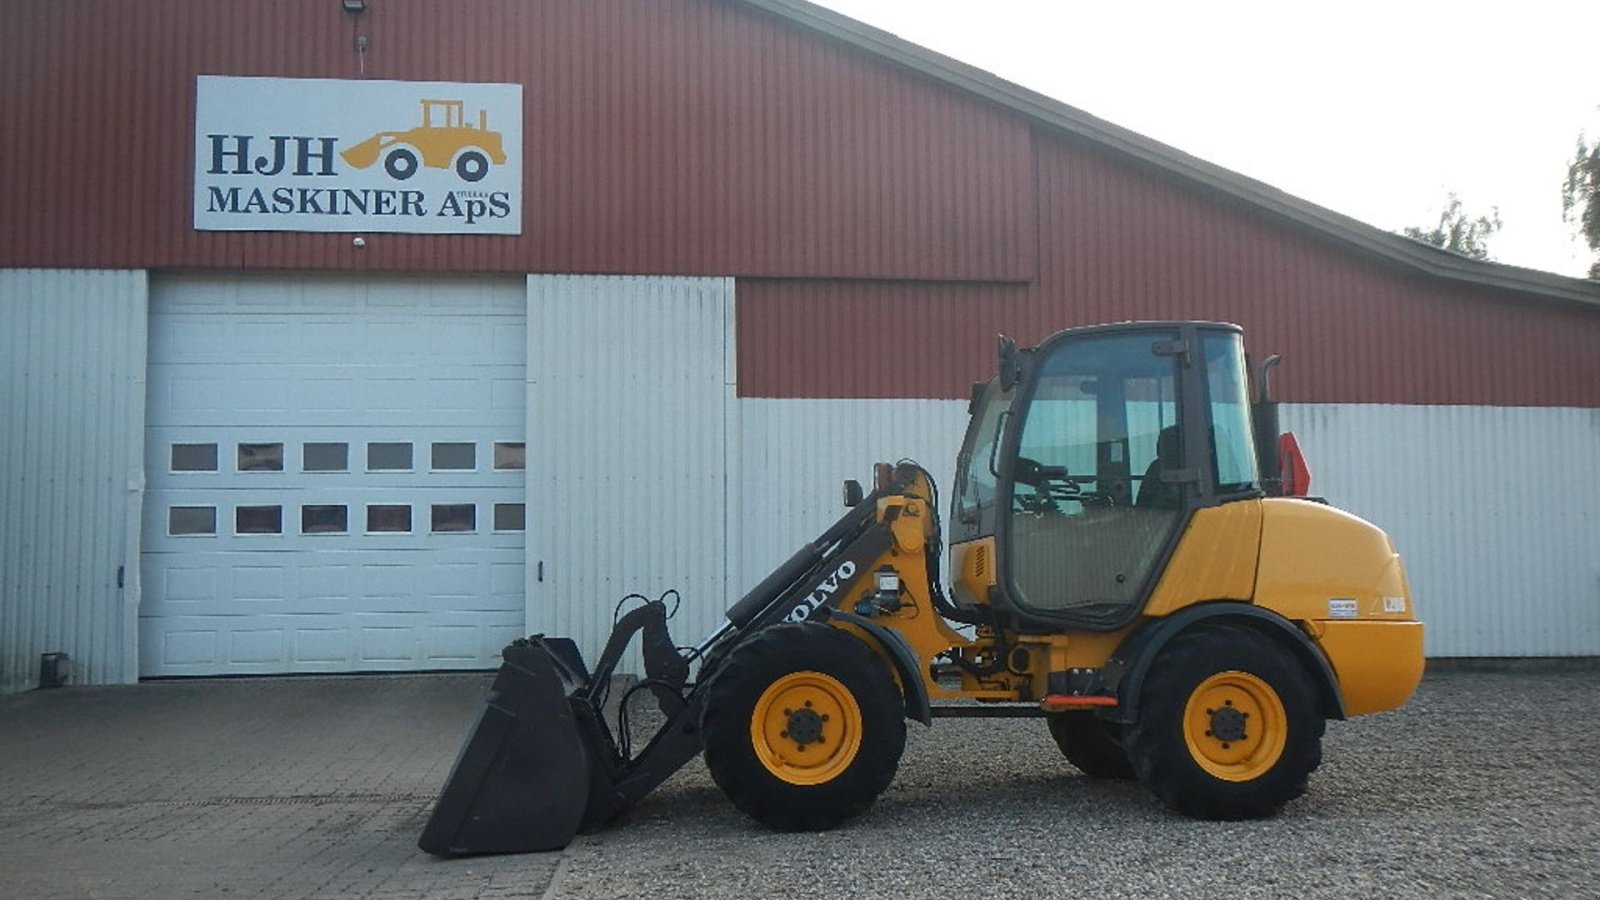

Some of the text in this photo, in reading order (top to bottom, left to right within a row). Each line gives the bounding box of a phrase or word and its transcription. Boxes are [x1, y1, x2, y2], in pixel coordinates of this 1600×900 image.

[206, 134, 338, 176] HJH
[206, 186, 511, 224] MASKINER ApS
